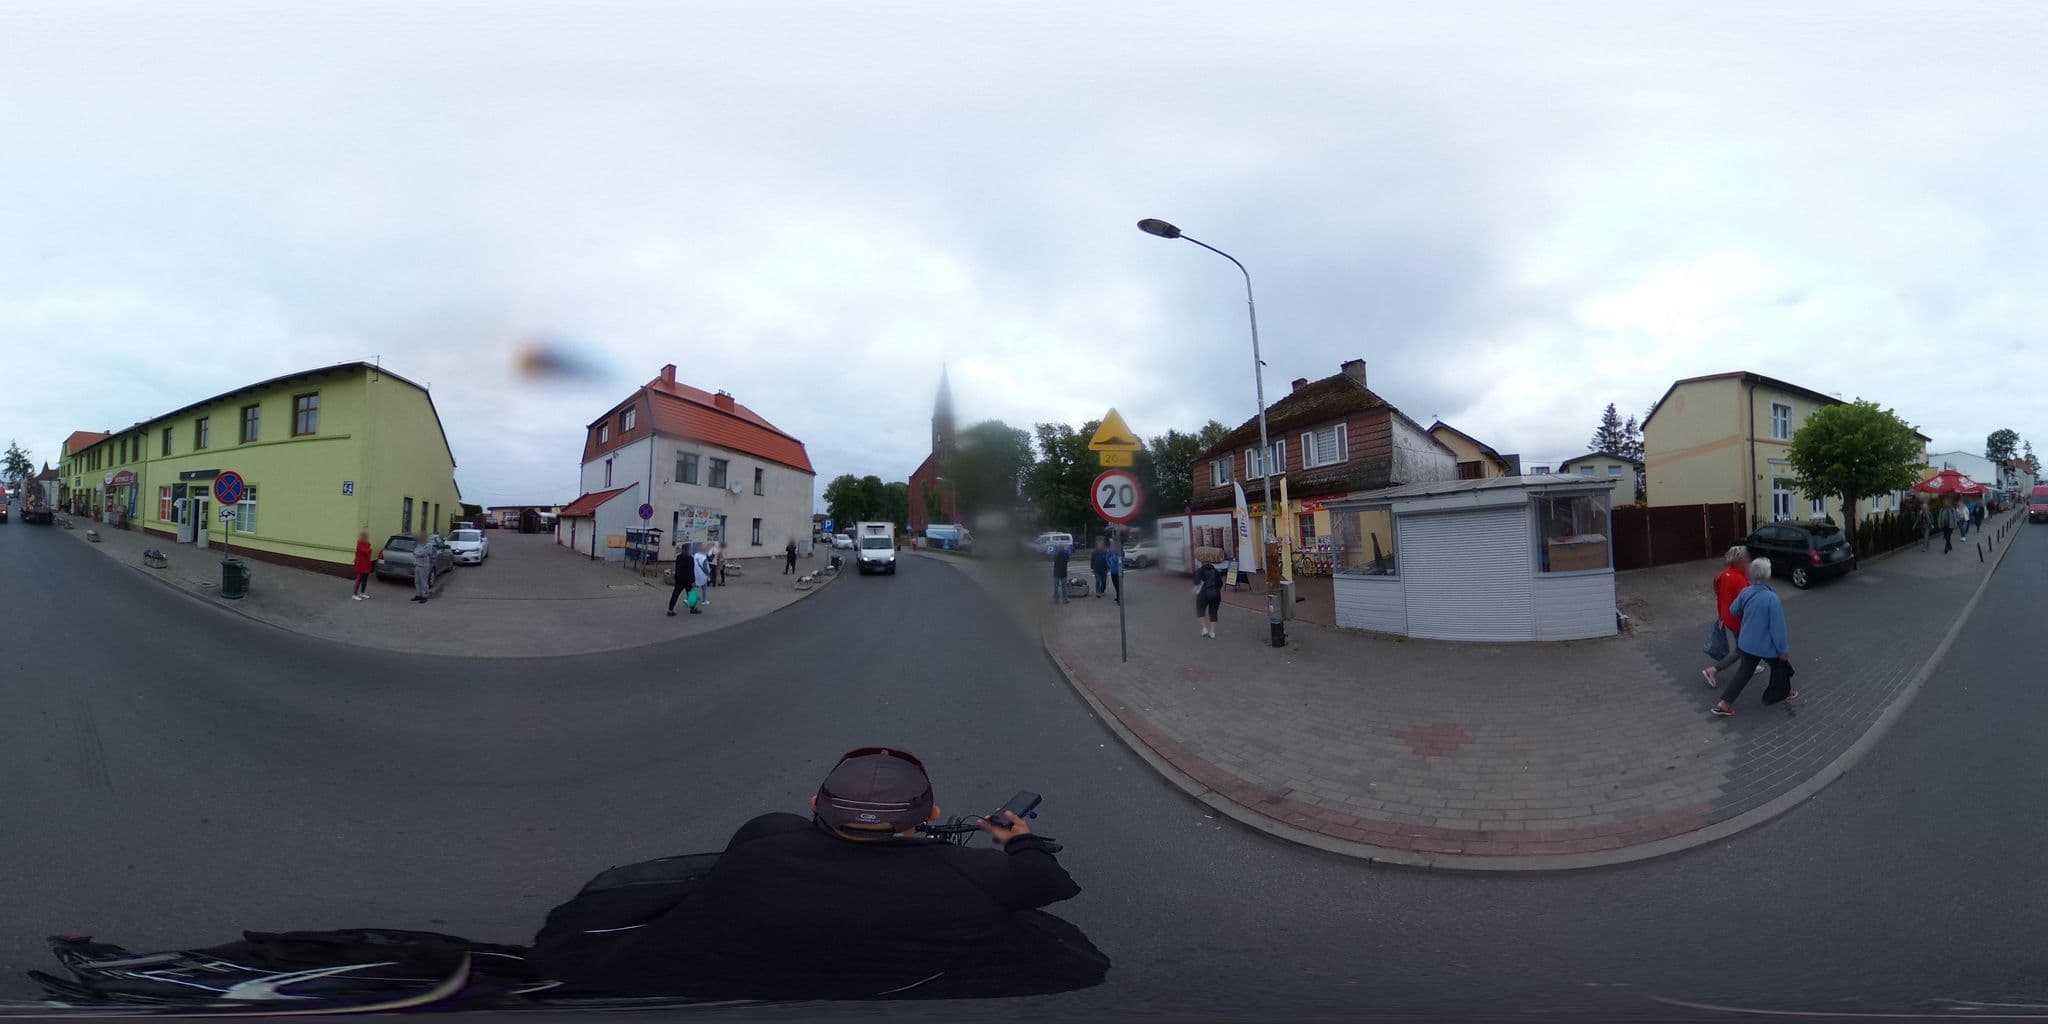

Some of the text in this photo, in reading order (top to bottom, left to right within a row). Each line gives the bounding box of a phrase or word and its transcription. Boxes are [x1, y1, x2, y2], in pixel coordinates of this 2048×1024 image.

[1105, 455, 1118, 463] 20
[1102, 484, 1134, 508] 20
[825, 520, 832, 528] P
